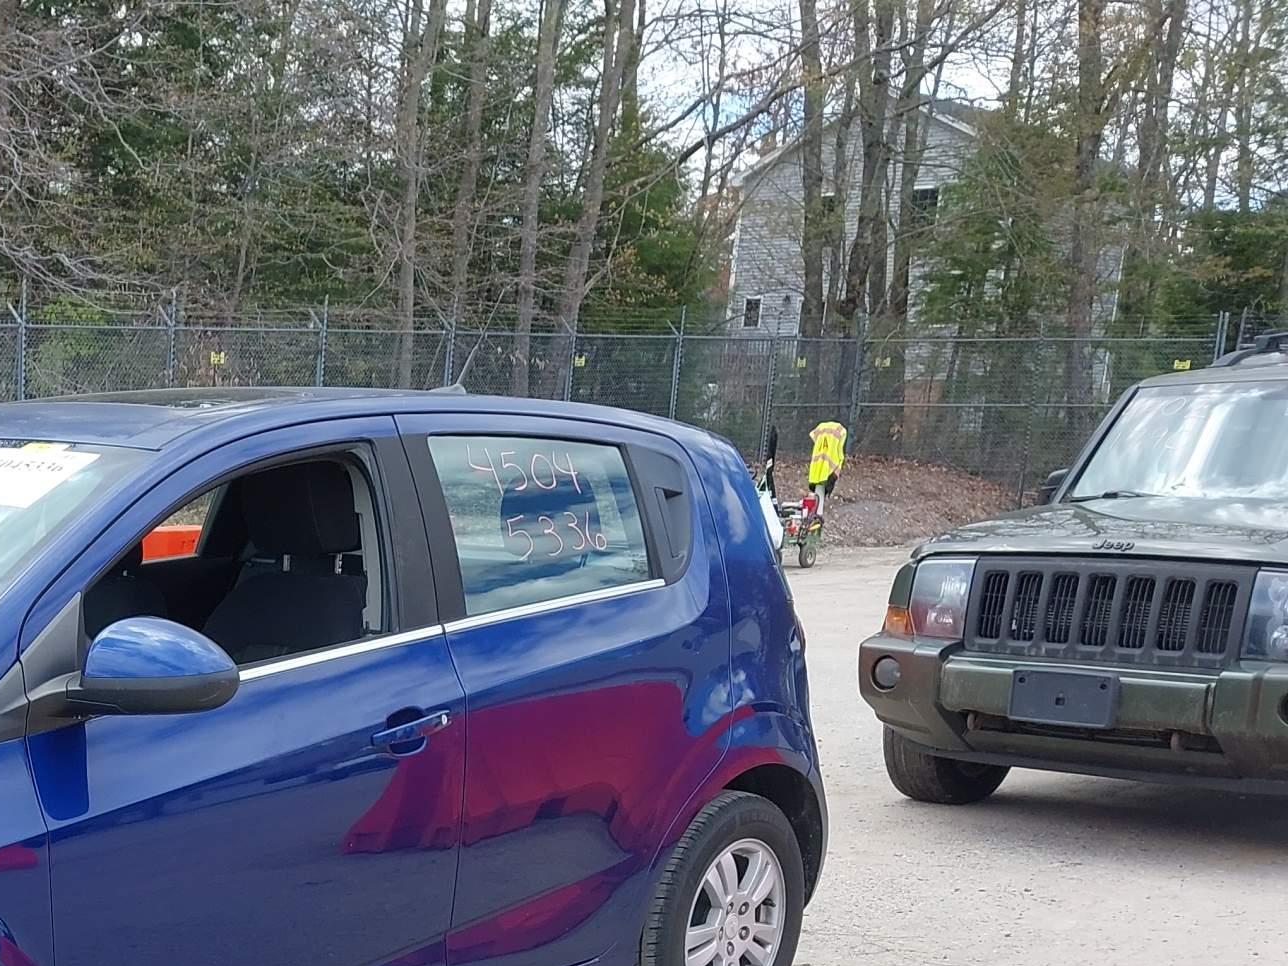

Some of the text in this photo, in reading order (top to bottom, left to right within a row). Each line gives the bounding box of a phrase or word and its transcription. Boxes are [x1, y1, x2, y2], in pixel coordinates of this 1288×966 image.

[466, 443, 582, 495] 4504
[506, 511, 608, 561] 5336
[1092, 538, 1135, 552] Jeep
